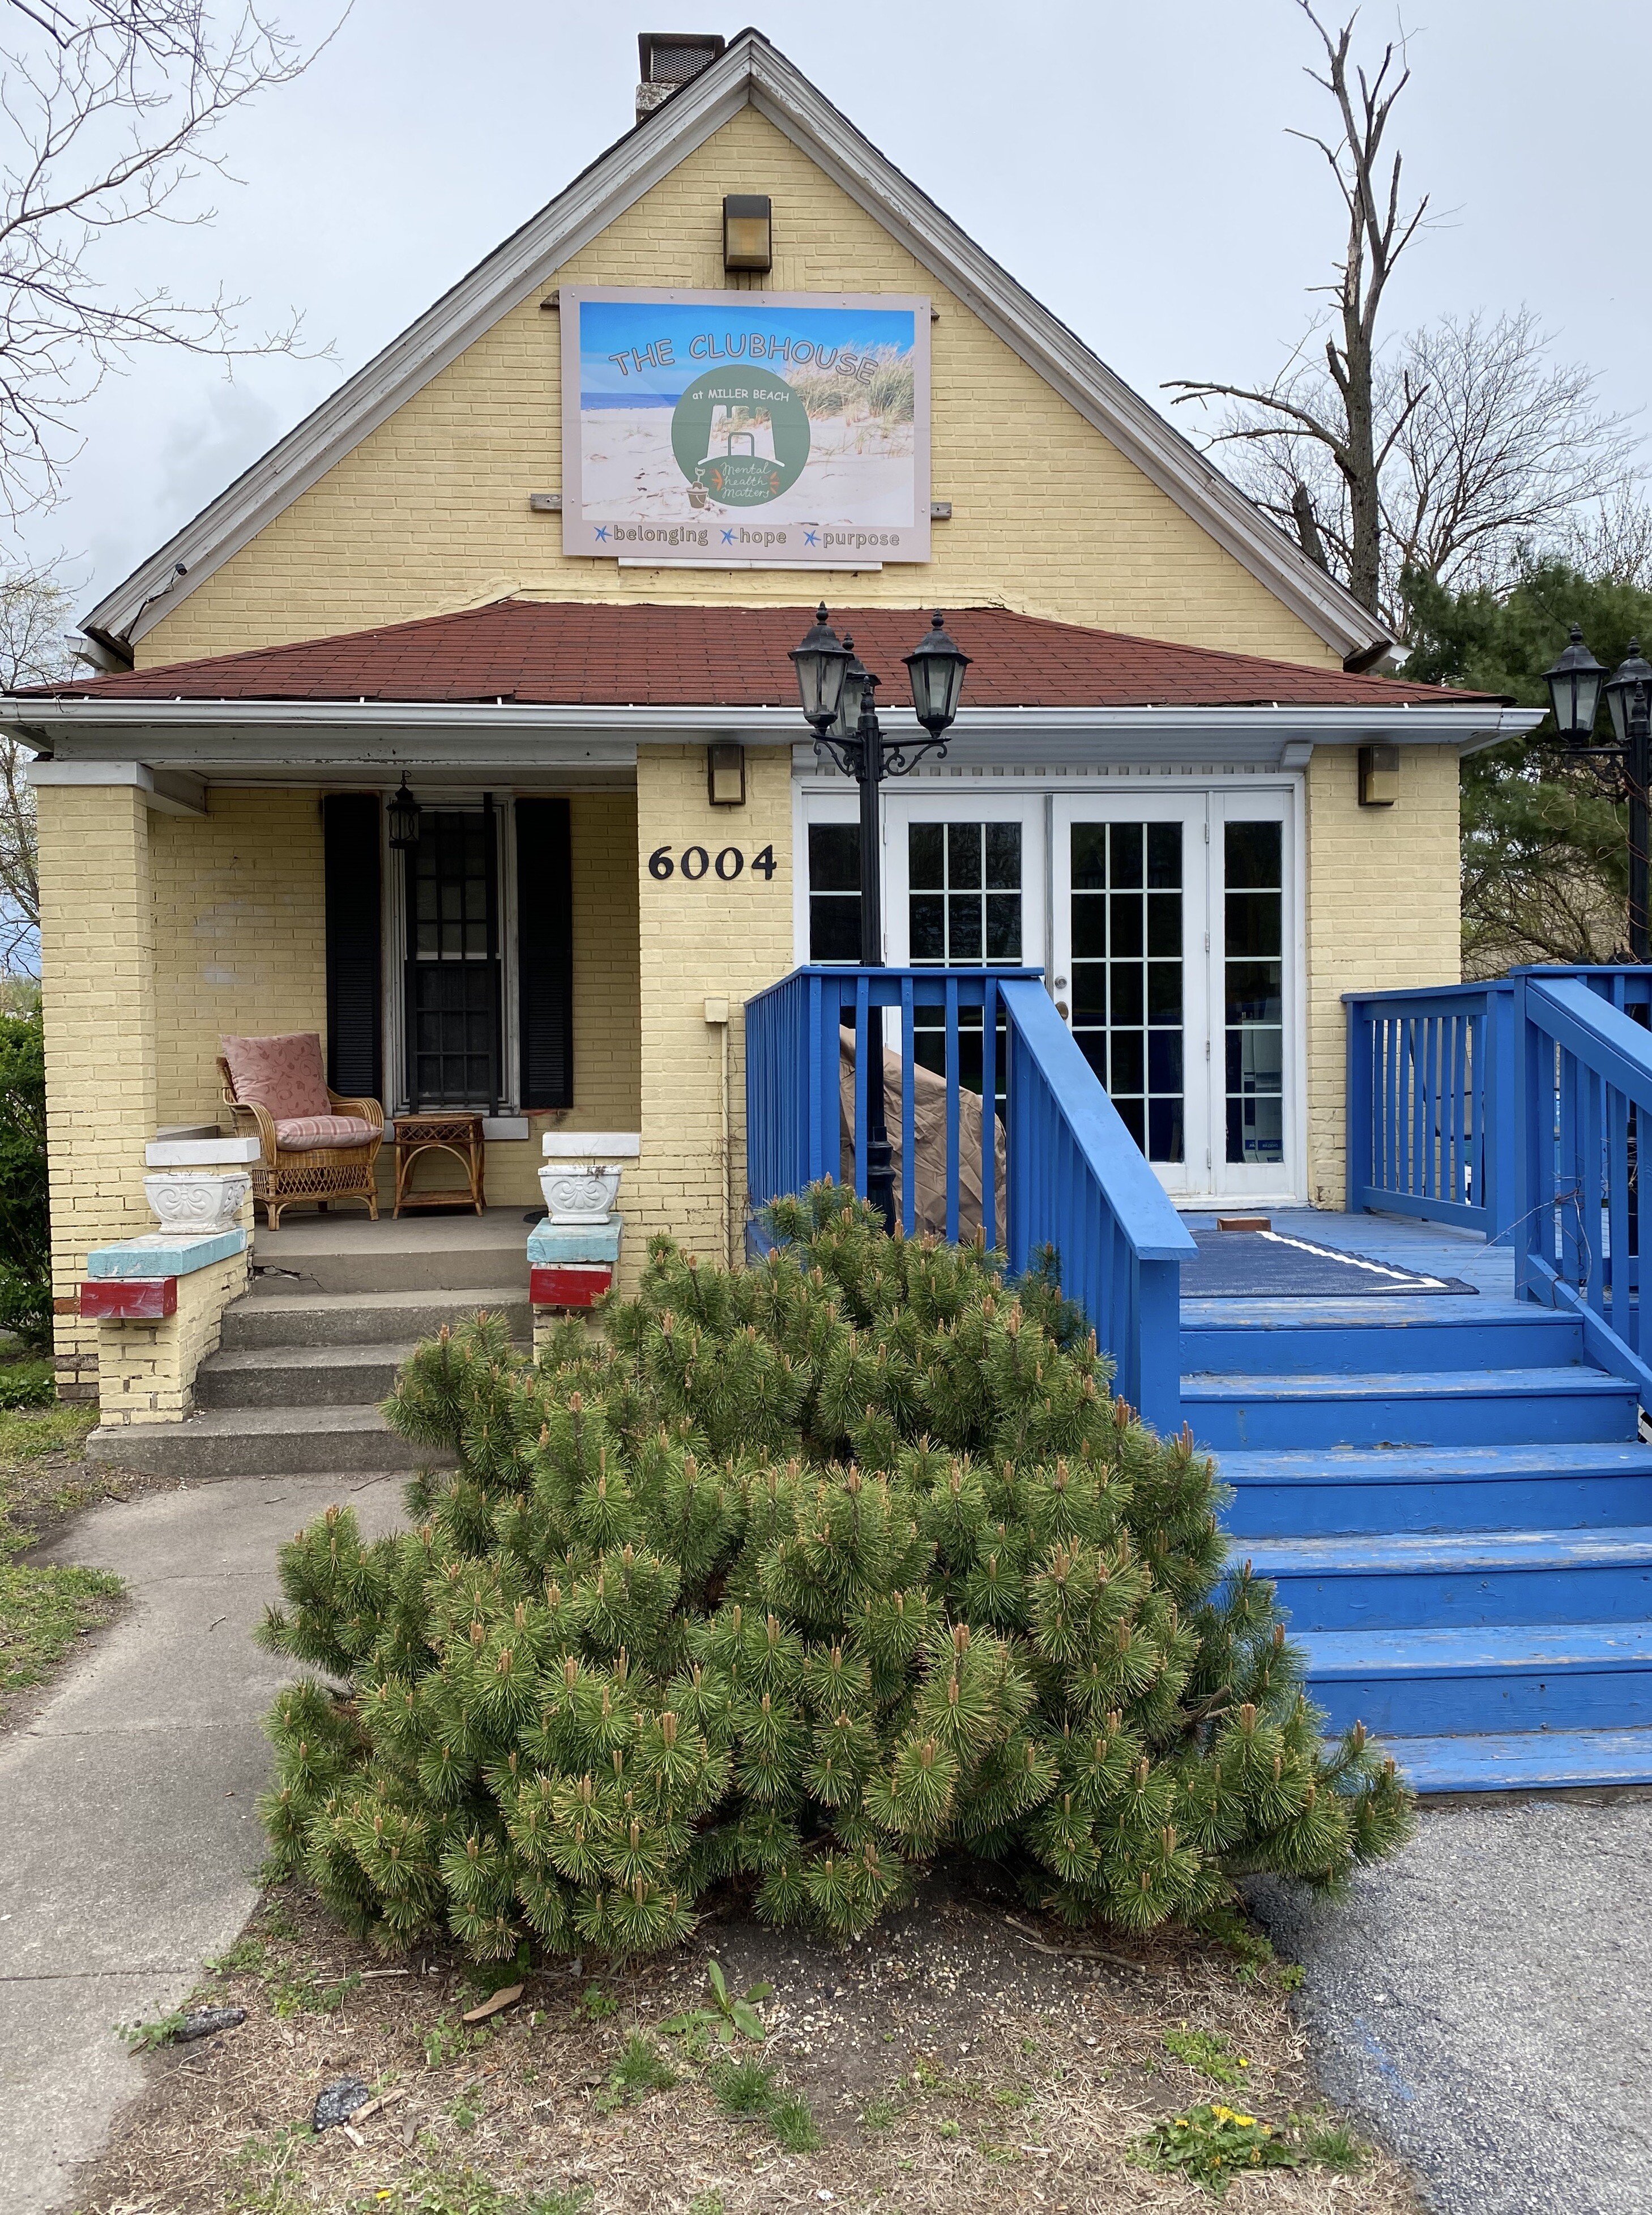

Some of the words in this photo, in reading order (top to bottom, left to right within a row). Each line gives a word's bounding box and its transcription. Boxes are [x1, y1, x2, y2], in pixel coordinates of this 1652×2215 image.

[608, 338, 675, 375] THE
[689, 333, 878, 385] CLUBHOUSE
[692, 390, 703, 399] at
[708, 389, 749, 399] MILLER
[753, 389, 789, 402] BEACH
[720, 462, 771, 476] Mental
[724, 475, 767, 486] health
[613, 525, 708, 546] belonging
[740, 528, 787, 547] hope
[823, 533, 899, 548] purpose
[648, 844, 777, 880] 6004
